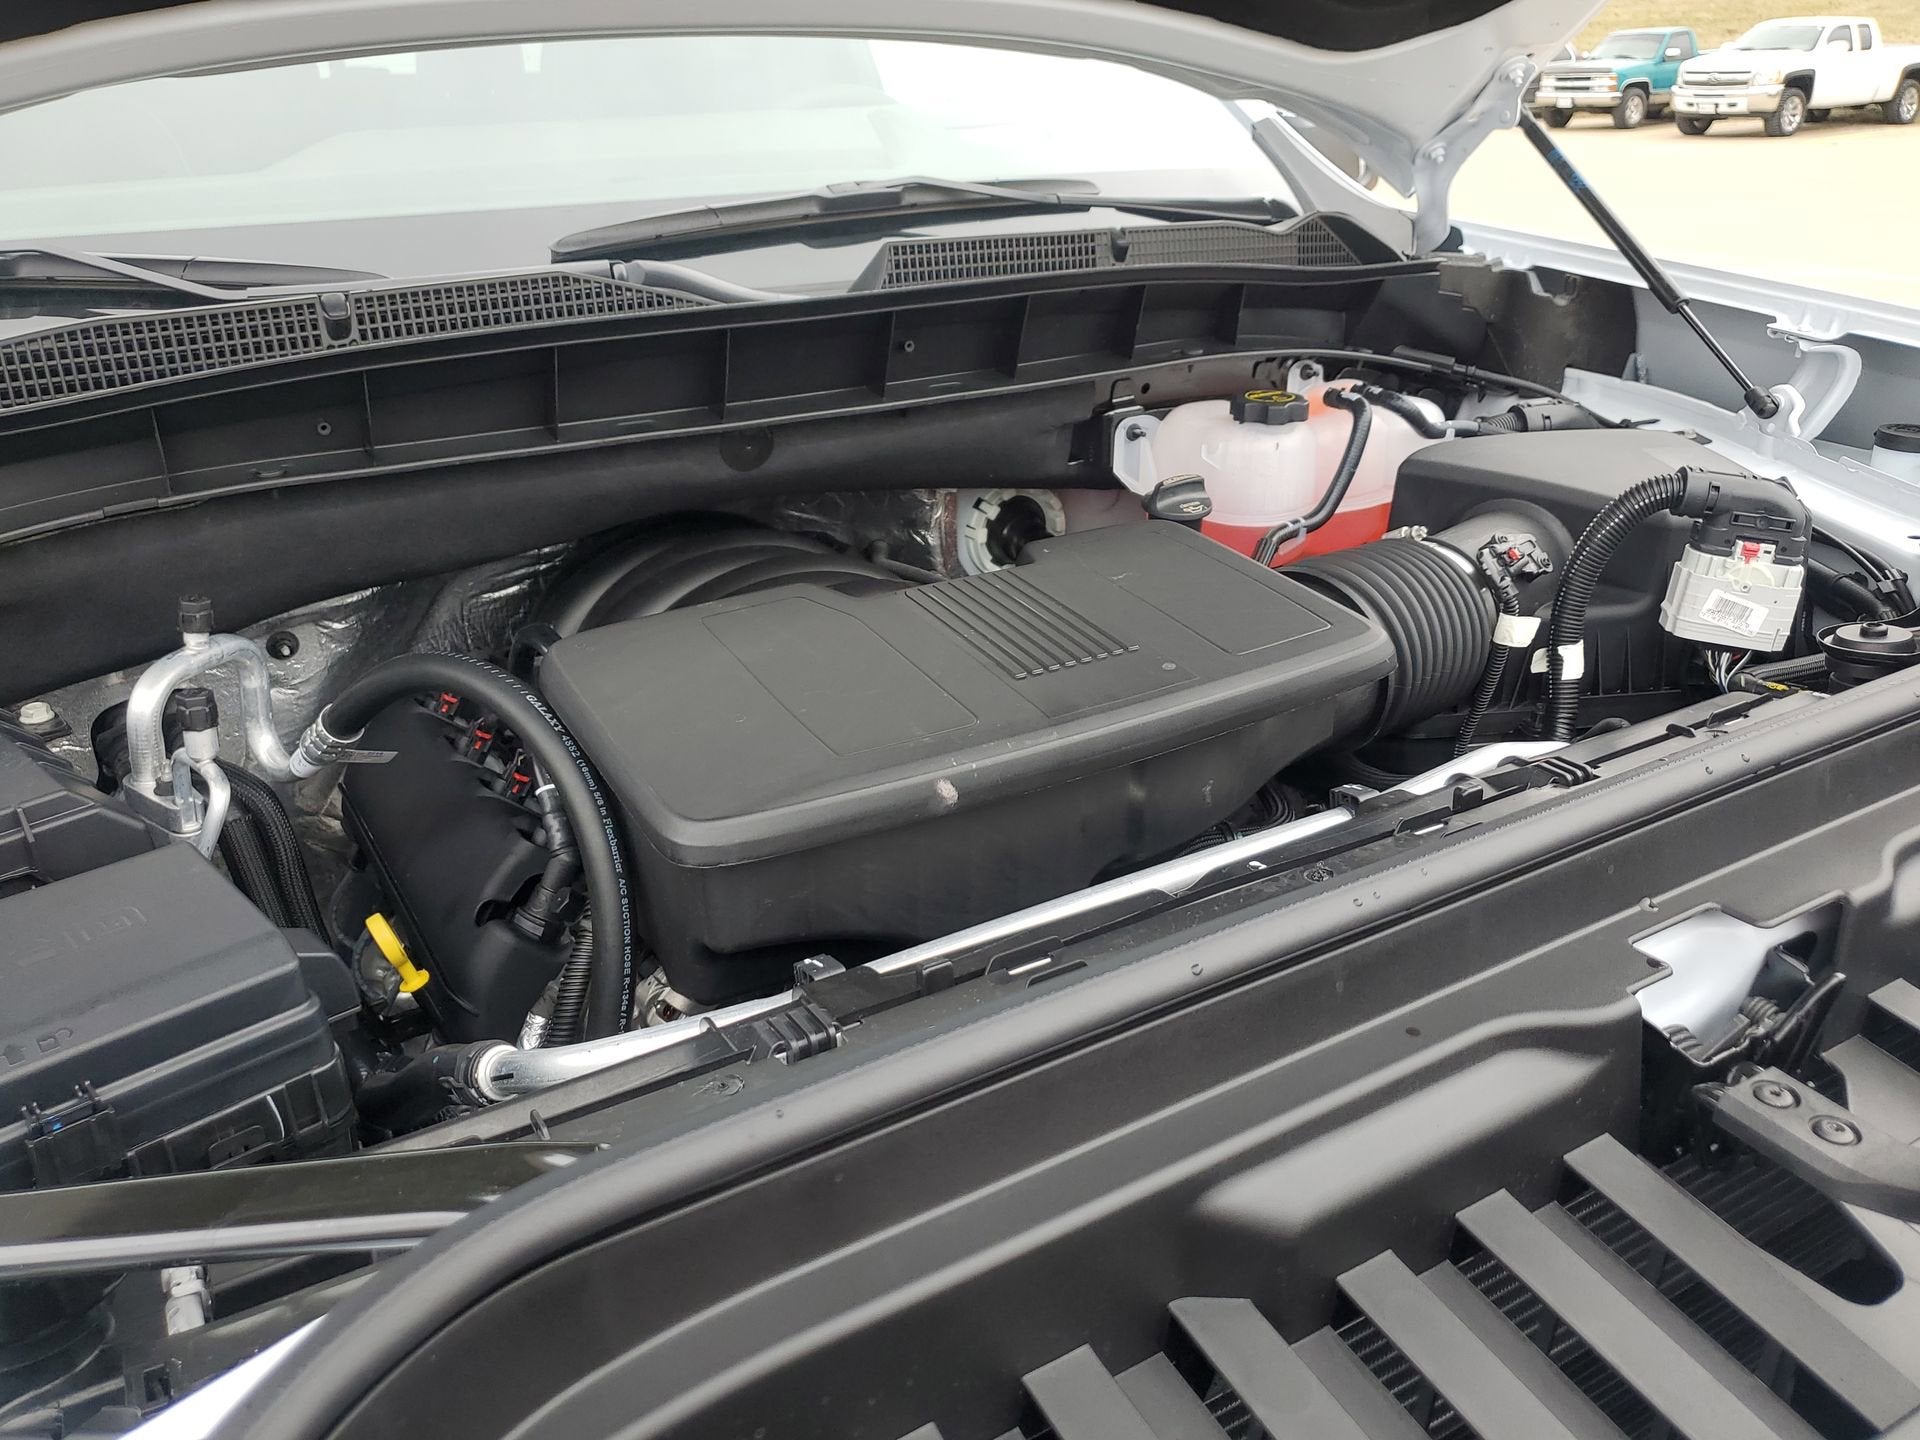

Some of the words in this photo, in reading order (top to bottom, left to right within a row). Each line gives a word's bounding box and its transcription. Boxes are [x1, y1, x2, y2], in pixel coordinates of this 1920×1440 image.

[525, 694, 566, 732] GALAXY
[562, 735, 581, 758] 4882
[576, 759, 598, 791] (16mm)
[602, 817, 623, 874] Flexbarrier
[622, 897, 632, 944] SUCTION
[623, 946, 632, 976] HOSE
